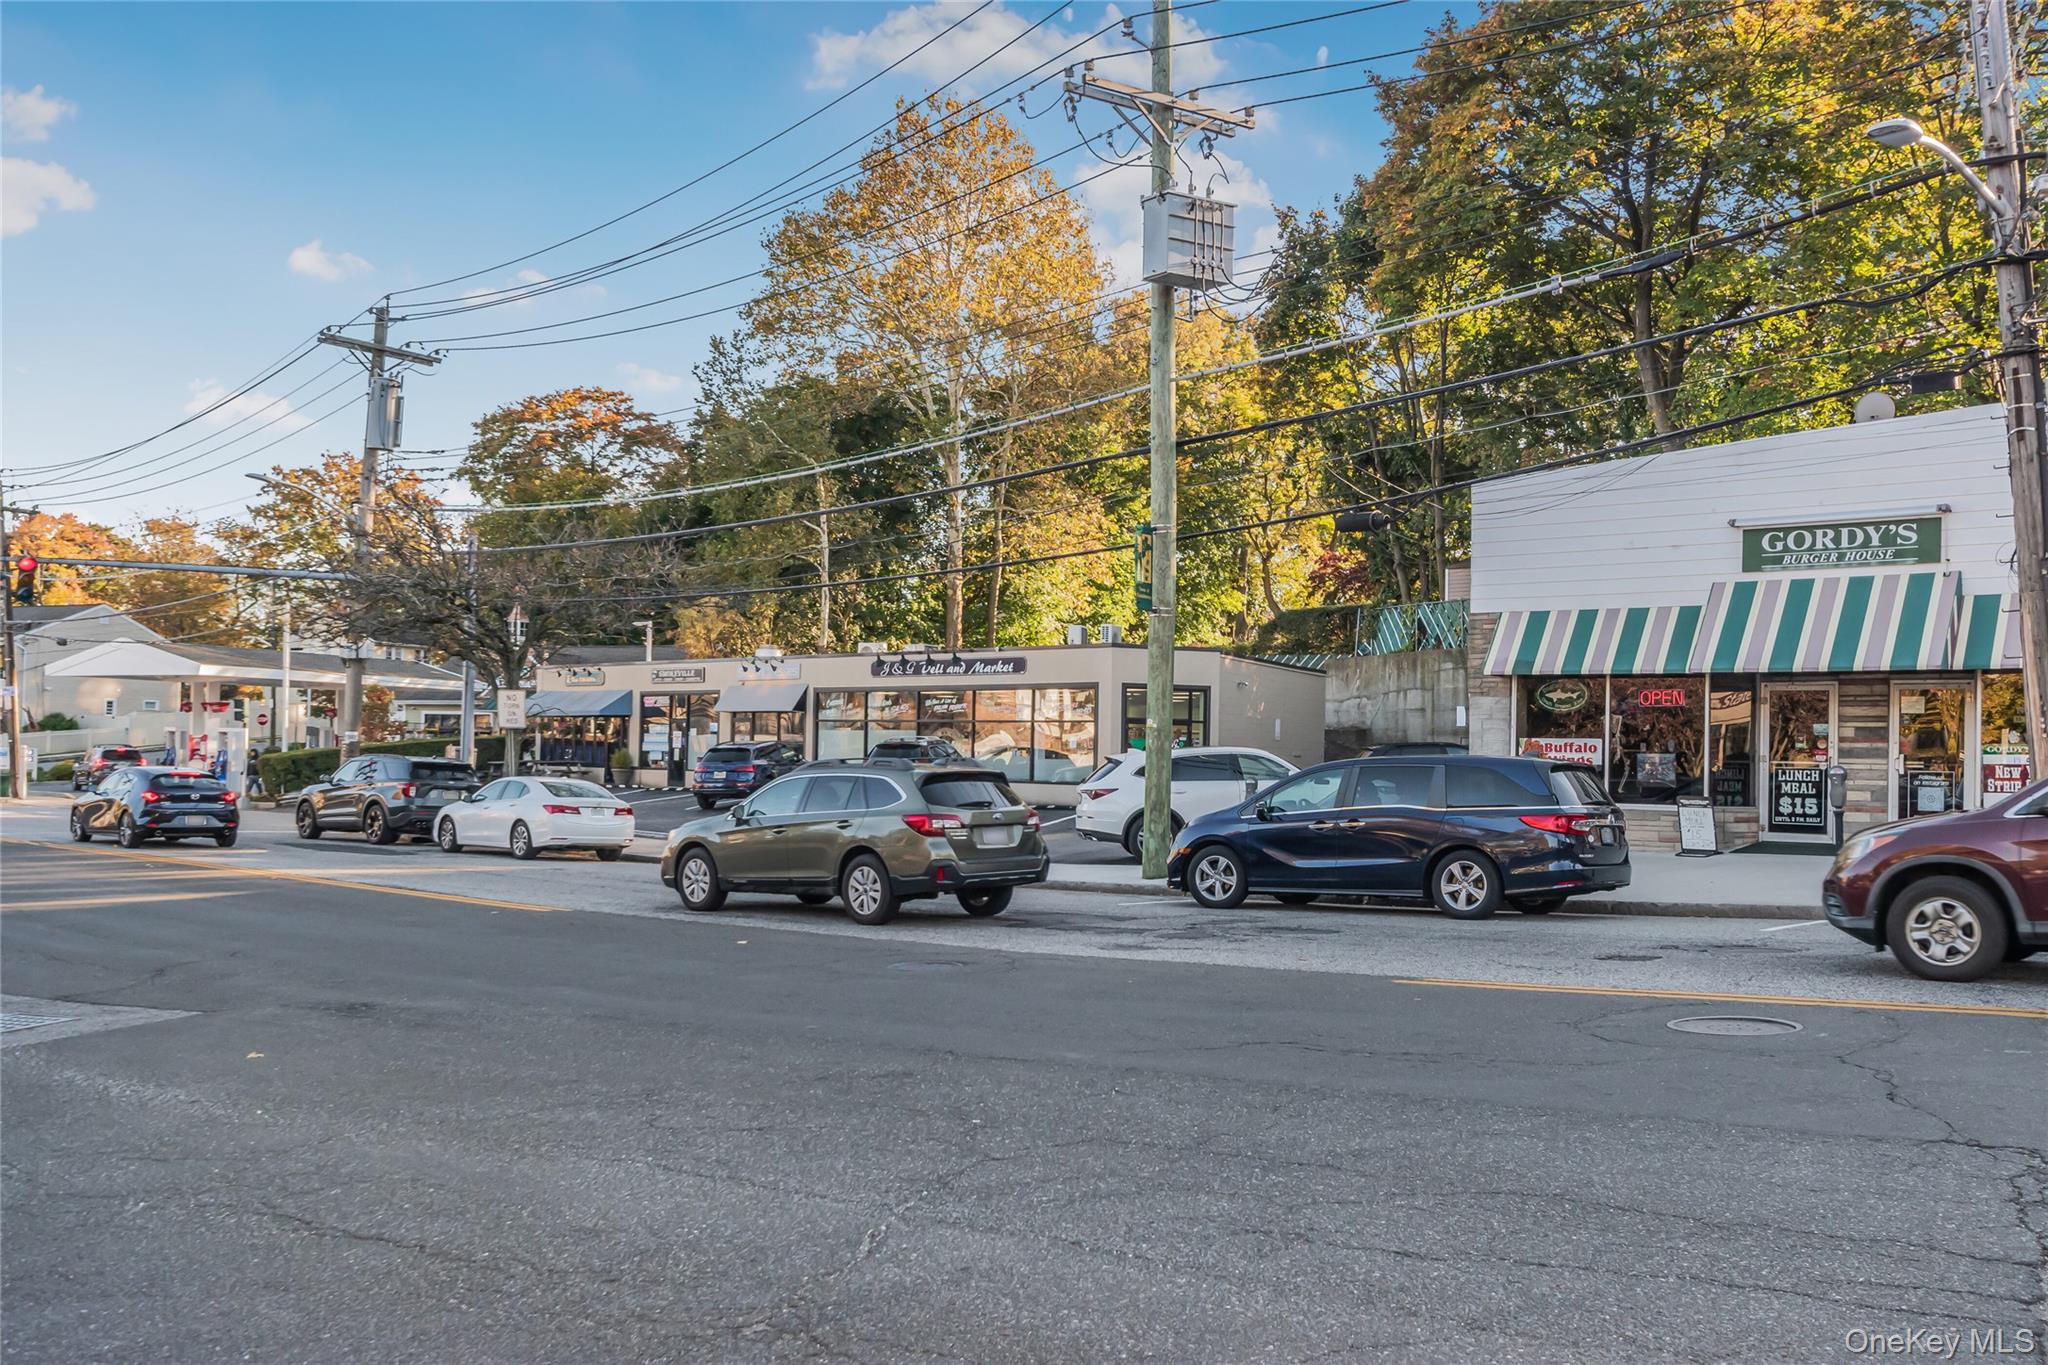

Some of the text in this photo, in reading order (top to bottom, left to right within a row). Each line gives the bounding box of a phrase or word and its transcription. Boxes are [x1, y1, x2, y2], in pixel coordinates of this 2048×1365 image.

[1761, 523, 1919, 552] GORDY'S
[1782, 549, 1896, 565] BURGER HOUSE
[892, 662, 904, 675] &
[946, 661, 965, 673] and
[968, 660, 1014, 675] Market
[1639, 690, 1684, 706] OPEN
[1544, 742, 1598, 753] Buffalo
[1778, 769, 1820, 781] LUNCH
[1988, 779, 2022, 792] STRIP
[1778, 795, 1819, 815] $15
